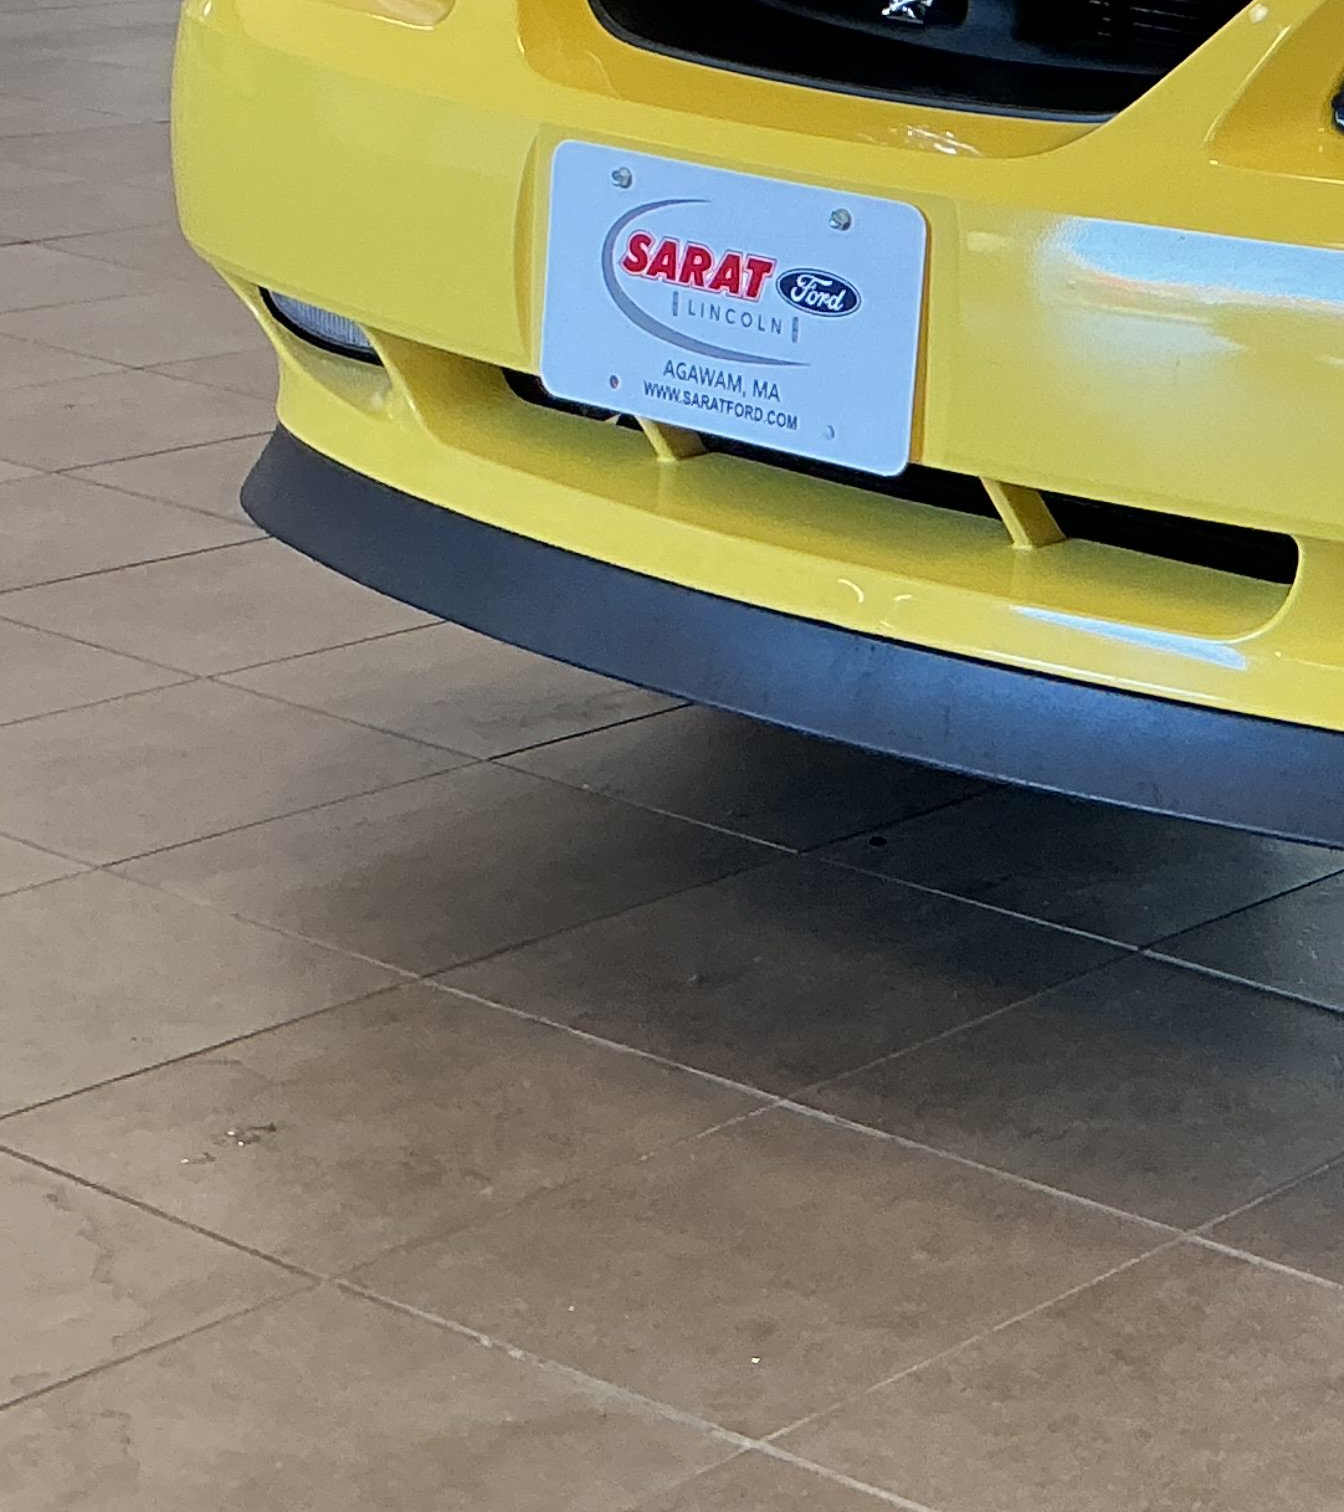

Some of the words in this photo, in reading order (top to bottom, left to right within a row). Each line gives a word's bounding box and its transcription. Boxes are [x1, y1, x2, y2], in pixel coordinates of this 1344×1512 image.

[620, 231, 776, 301] SARAT
[789, 272, 846, 312] Ford
[687, 298, 783, 335] LINCOLN
[663, 359, 747, 398] AGAWAM,
[752, 378, 781, 402] MA
[643, 379, 799, 431] WWW.SARATFORD.COM
